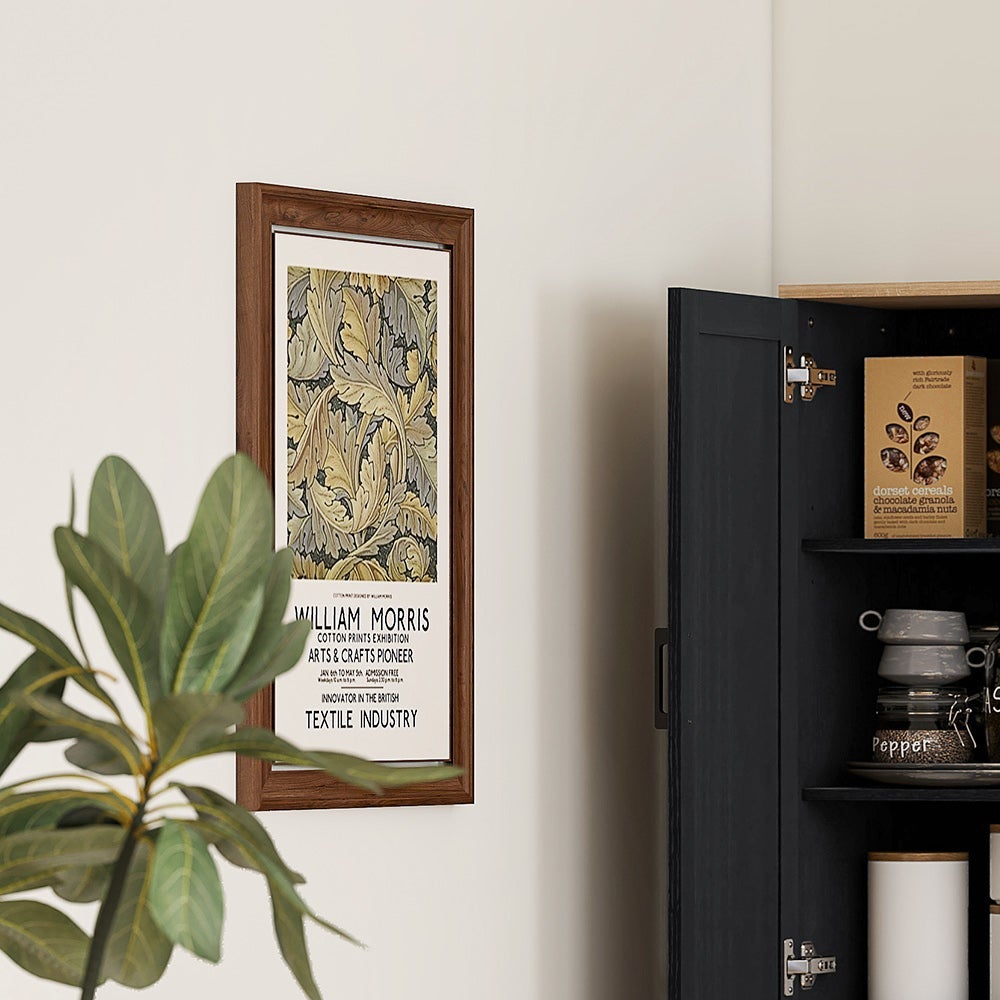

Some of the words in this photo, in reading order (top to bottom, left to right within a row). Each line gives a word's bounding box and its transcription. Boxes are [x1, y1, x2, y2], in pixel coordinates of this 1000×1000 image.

[873, 485, 910, 496] dorset
[911, 485, 953, 496] cereals
[873, 496, 917, 505] chocolate
[918, 496, 955, 505] granola
[873, 505, 882, 514] &
[883, 505, 935, 514] macadamia
[936, 505, 958, 514] nuts
[295, 606, 360, 630] WILLIAM
[371, 607, 430, 632] MORRIS
[317, 633, 347, 643] COTTON
[348, 633, 371, 643] PRINTS
[373, 633, 410, 643] EXHIBITION
[308, 648, 331, 663] ARTS
[333, 648, 339, 663] &
[341, 648, 375, 663] CRAFTS
[377, 648, 414, 663] PIONEER
[321, 693, 357, 703] INNOVATOR
[358, 693, 364, 703] IN
[365, 693, 377, 703] THE
[378, 693, 399, 703] BRITISH
[305, 710, 353, 729] TEXTILE
[360, 709, 418, 728] INDUSTRY
[872, 737, 930, 758] Pepper
